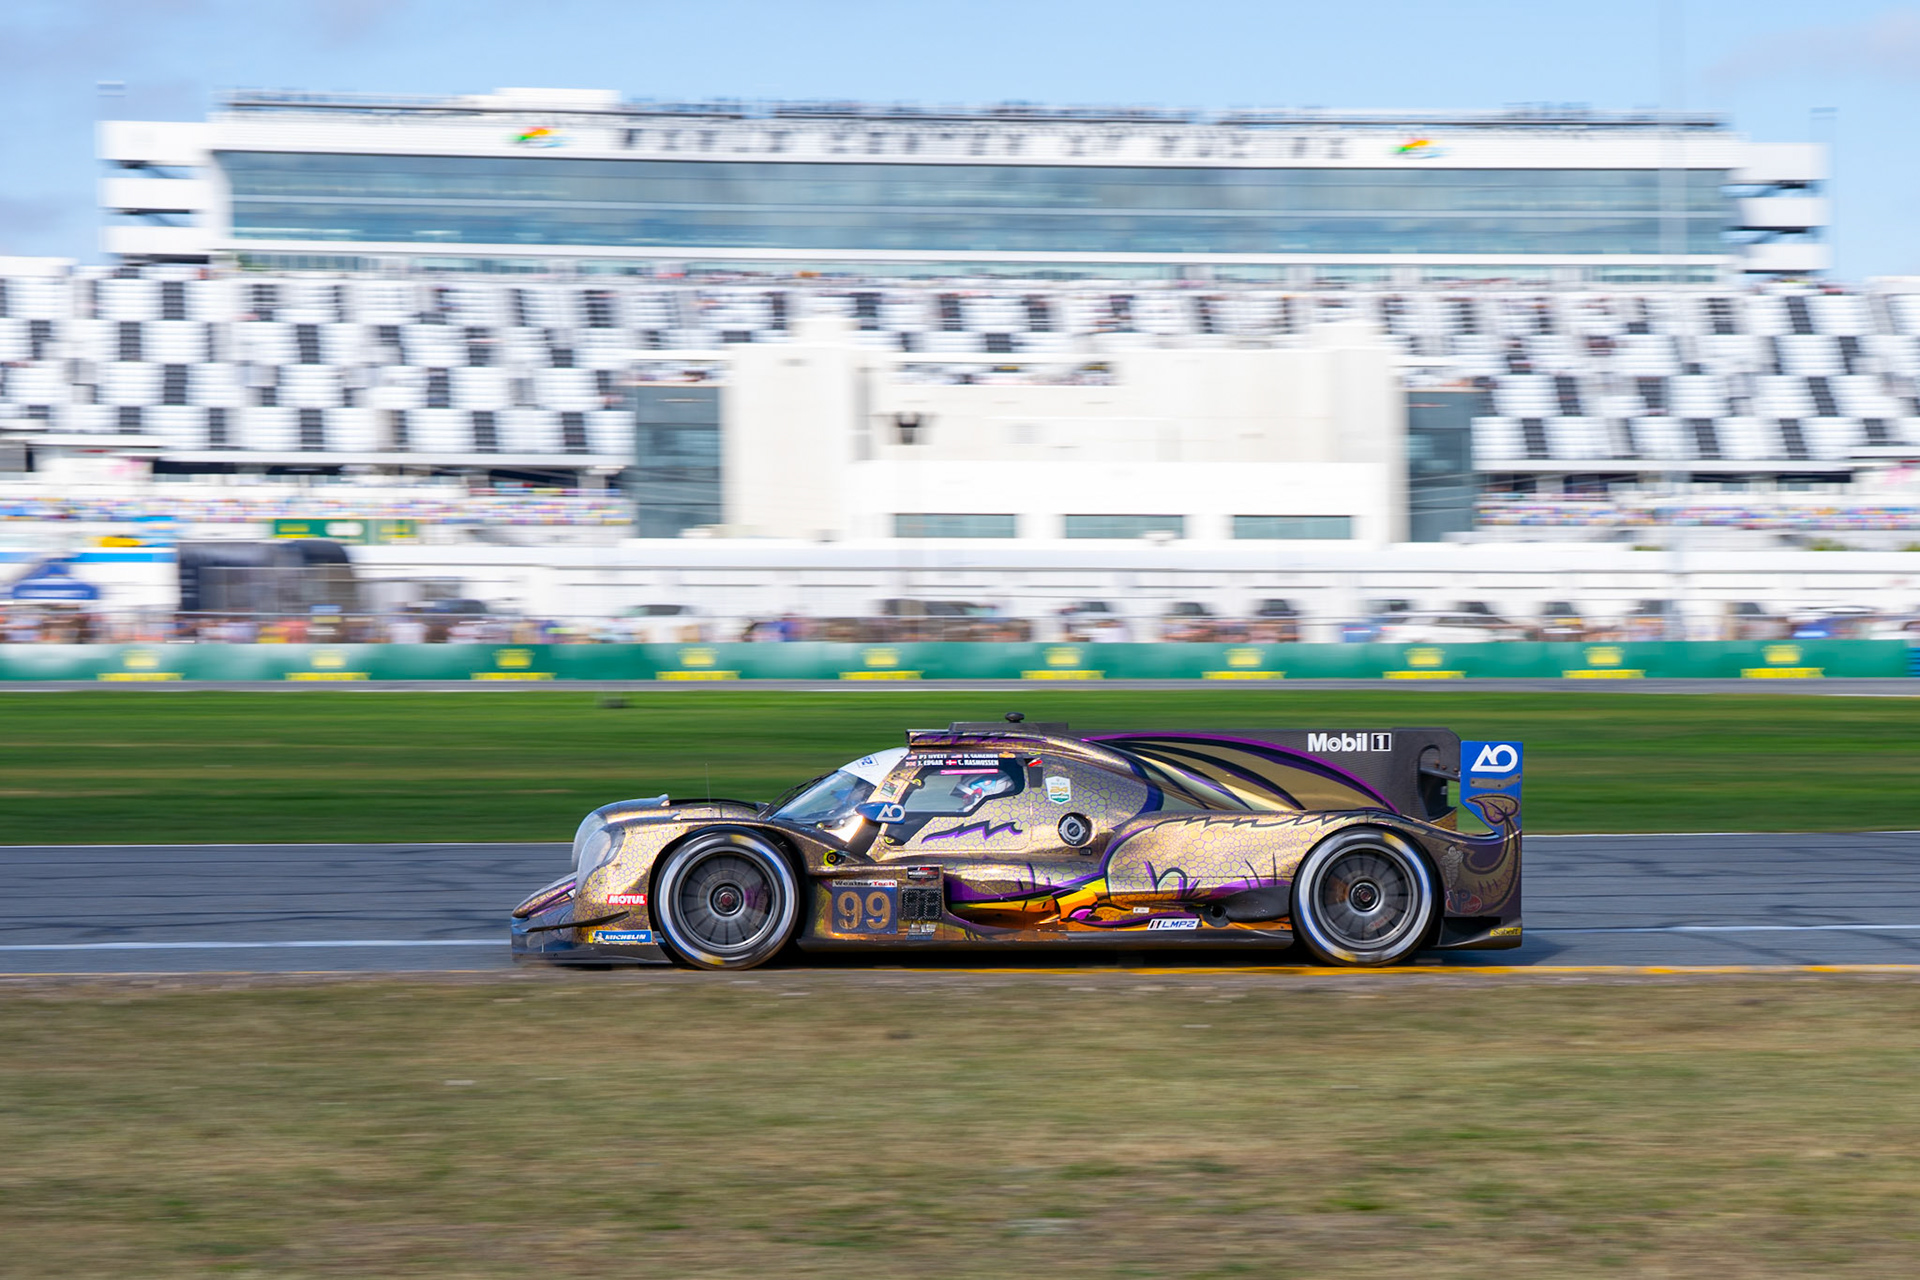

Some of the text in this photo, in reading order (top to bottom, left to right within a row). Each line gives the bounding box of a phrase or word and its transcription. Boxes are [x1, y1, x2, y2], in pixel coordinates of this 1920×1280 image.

[1307, 733, 1368, 752] Mobil
[608, 895, 646, 905] MOTUL
[837, 891, 891, 930] 99
[1161, 920, 1196, 929] LMP2
